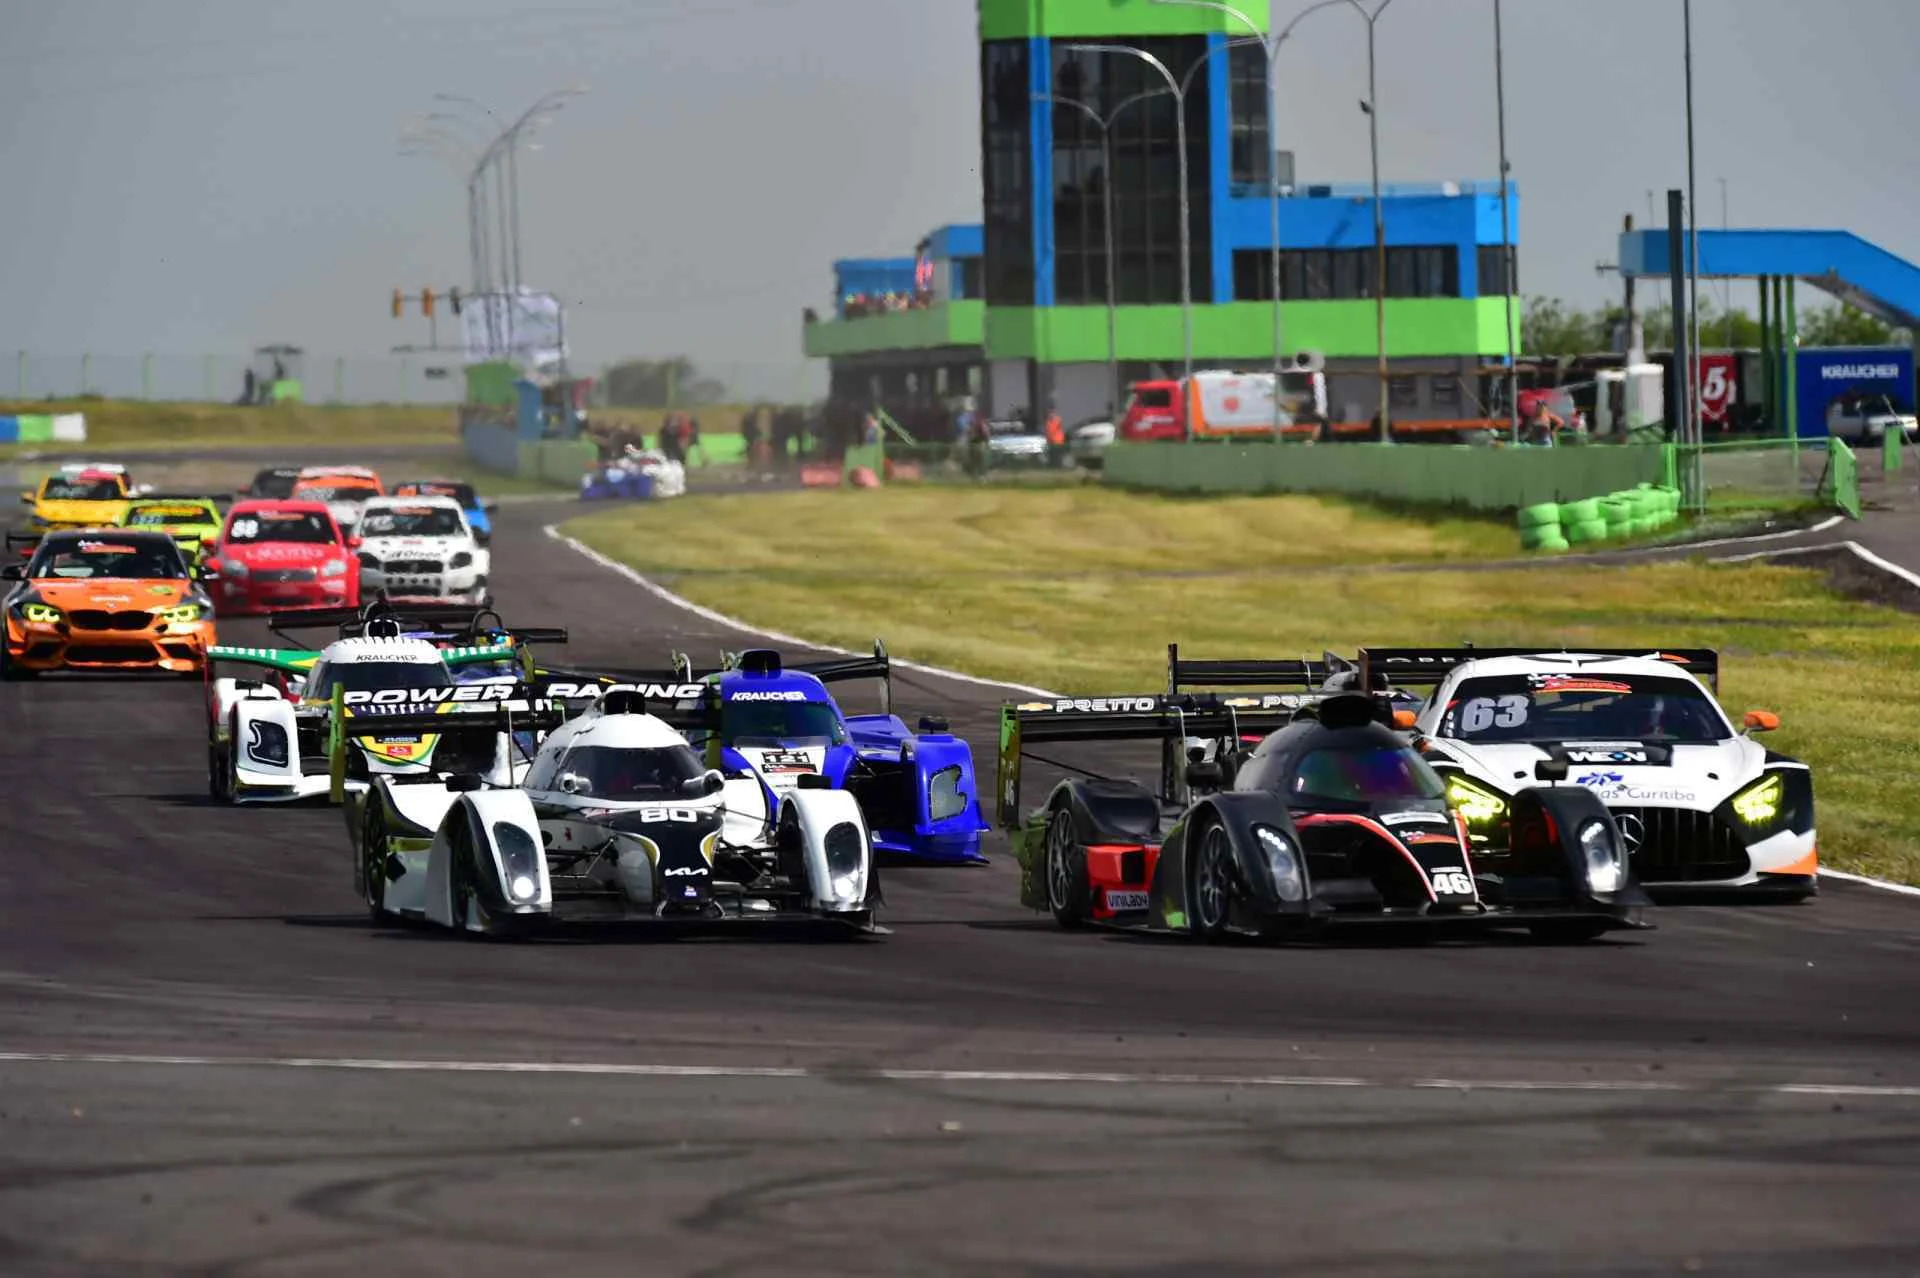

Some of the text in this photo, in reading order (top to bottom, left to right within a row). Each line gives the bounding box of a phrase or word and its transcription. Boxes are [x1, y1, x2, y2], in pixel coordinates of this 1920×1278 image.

[1821, 364, 1899, 379] KRAUCHER
[1704, 367, 1727, 399] 5
[355, 654, 418, 662] KRAUCHER
[343, 685, 514, 704] POWER
[731, 691, 807, 701] KRAUCHER
[1056, 697, 1154, 712] PRETTO
[1461, 695, 1530, 732] 63
[639, 808, 698, 823] 80
[1432, 873, 1473, 895] 46
